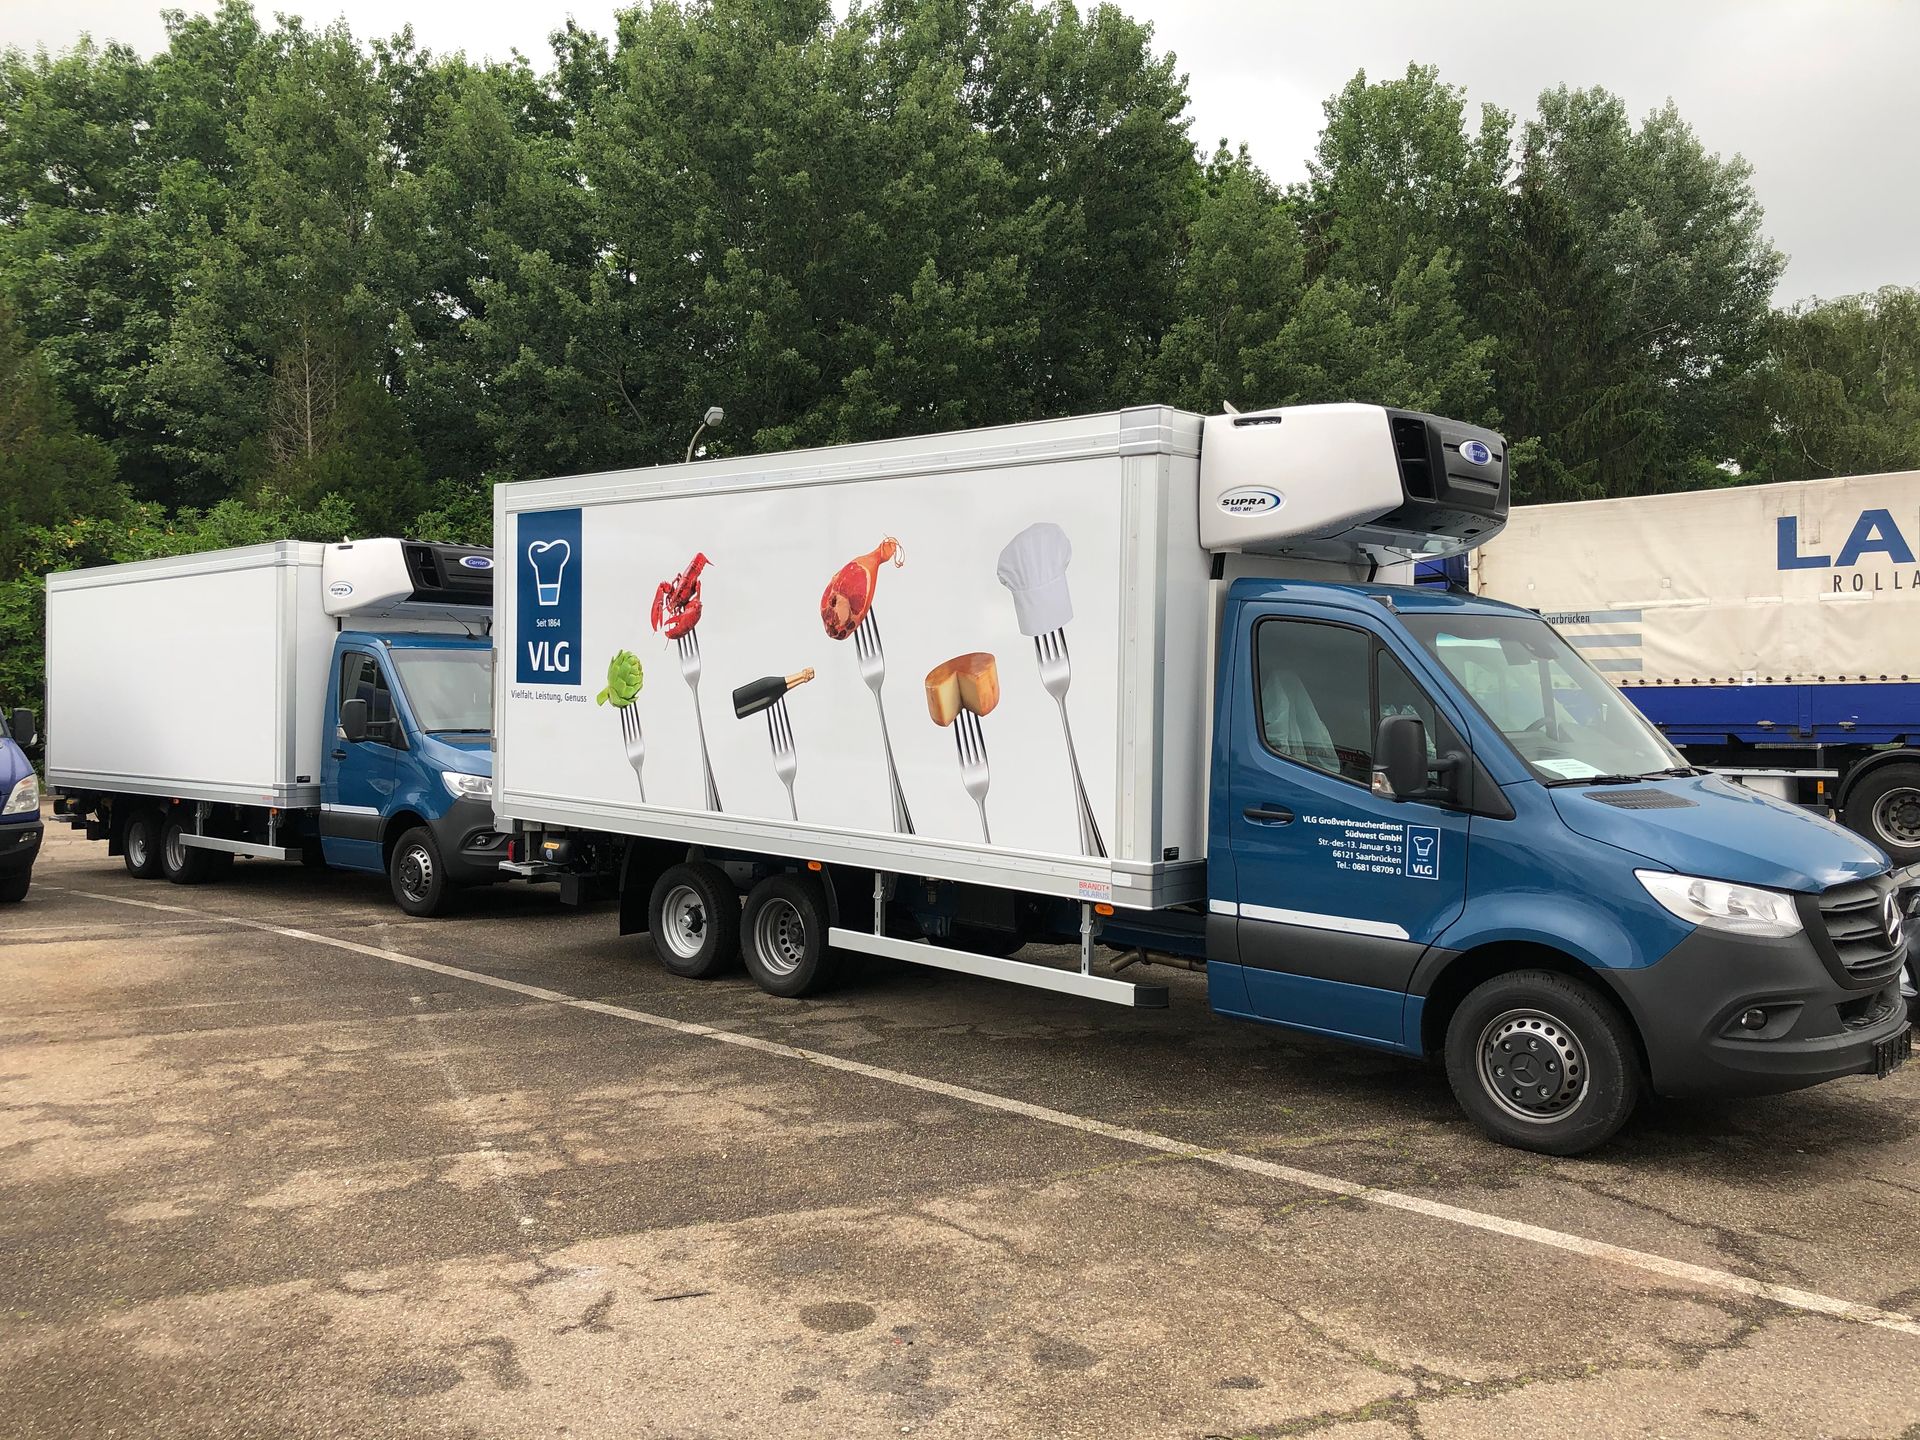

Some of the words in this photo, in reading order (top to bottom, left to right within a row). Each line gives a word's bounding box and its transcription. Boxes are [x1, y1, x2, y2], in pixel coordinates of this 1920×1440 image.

[1221, 497, 1266, 506] SUPRA
[536, 618, 547, 627] Seit
[1543, 612, 1590, 625] aarbrücken
[528, 641, 570, 672] VLG
[511, 689, 534, 700] Vielfalt,
[535, 691, 563, 703] Leistung,
[564, 692, 587, 703] Genuss
[1303, 815, 1317, 824] VLG
[1318, 817, 1403, 831] Großverbraucherdienst
[1345, 829, 1377, 841] Südwest
[1378, 833, 1402, 842] GmbH
[1318, 837, 1358, 849] Str.-des-13.
[1359, 841, 1384, 851] Januar
[1385, 843, 1402, 853] 9-13
[1332, 850, 1354, 859] 66121
[1355, 852, 1402, 864] Saarbrücken
[1336, 861, 1351, 869] Tel.:
[1352, 863, 1370, 872] 0681
[1371, 865, 1394, 874] 68709
[1396, 867, 1402, 875] 0
[1412, 863, 1433, 875] VLG
[1078, 881, 1106, 891] BRANDT
